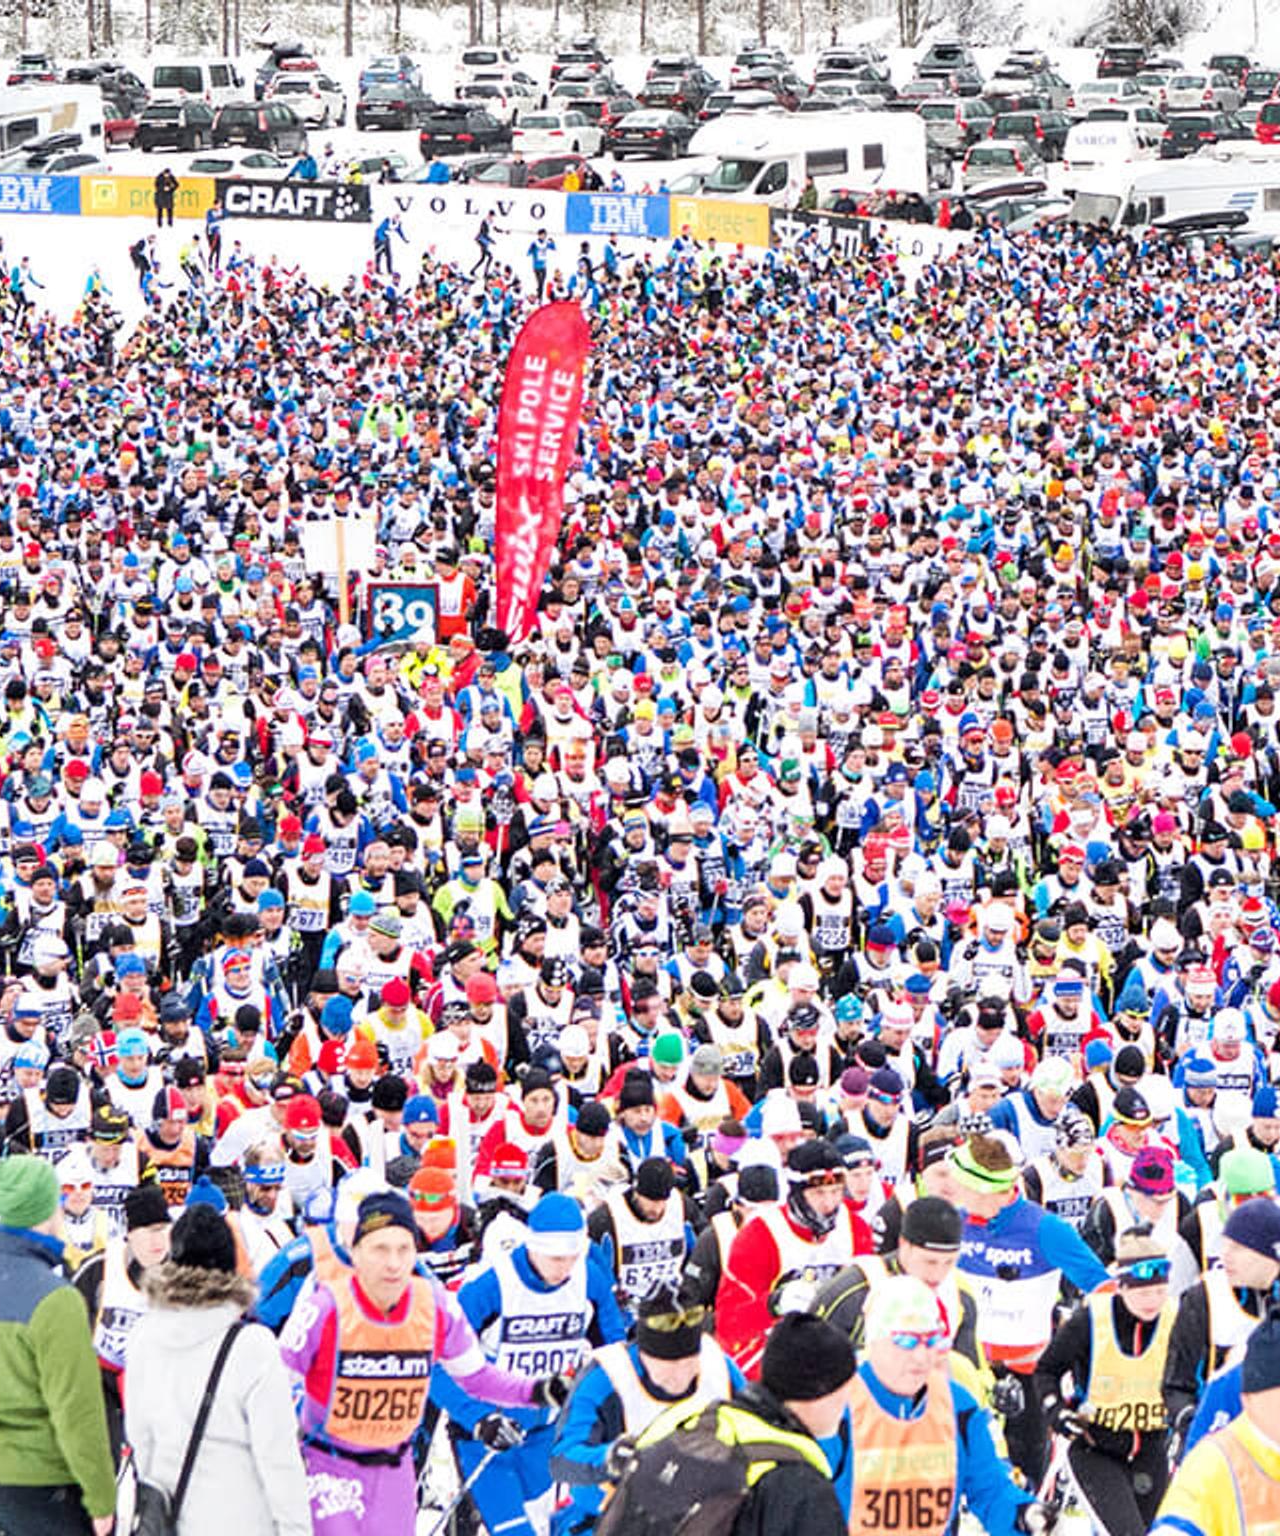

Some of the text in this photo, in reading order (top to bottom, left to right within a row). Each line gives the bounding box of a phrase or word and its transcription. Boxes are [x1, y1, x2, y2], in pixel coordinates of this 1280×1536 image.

[225, 186, 332, 216] CRAFT
[395, 197, 546, 220] VOLVO
[589, 197, 648, 233] IBM
[512, 355, 548, 479] SKI POLE
[536, 369, 576, 482] SERVICE
[987, 1248, 1033, 1267] sport
[509, 1318, 563, 1336] CRAFT
[340, 1355, 429, 1376] stadium
[334, 1387, 425, 1421] 30266
[861, 1488, 952, 1531] 30169
